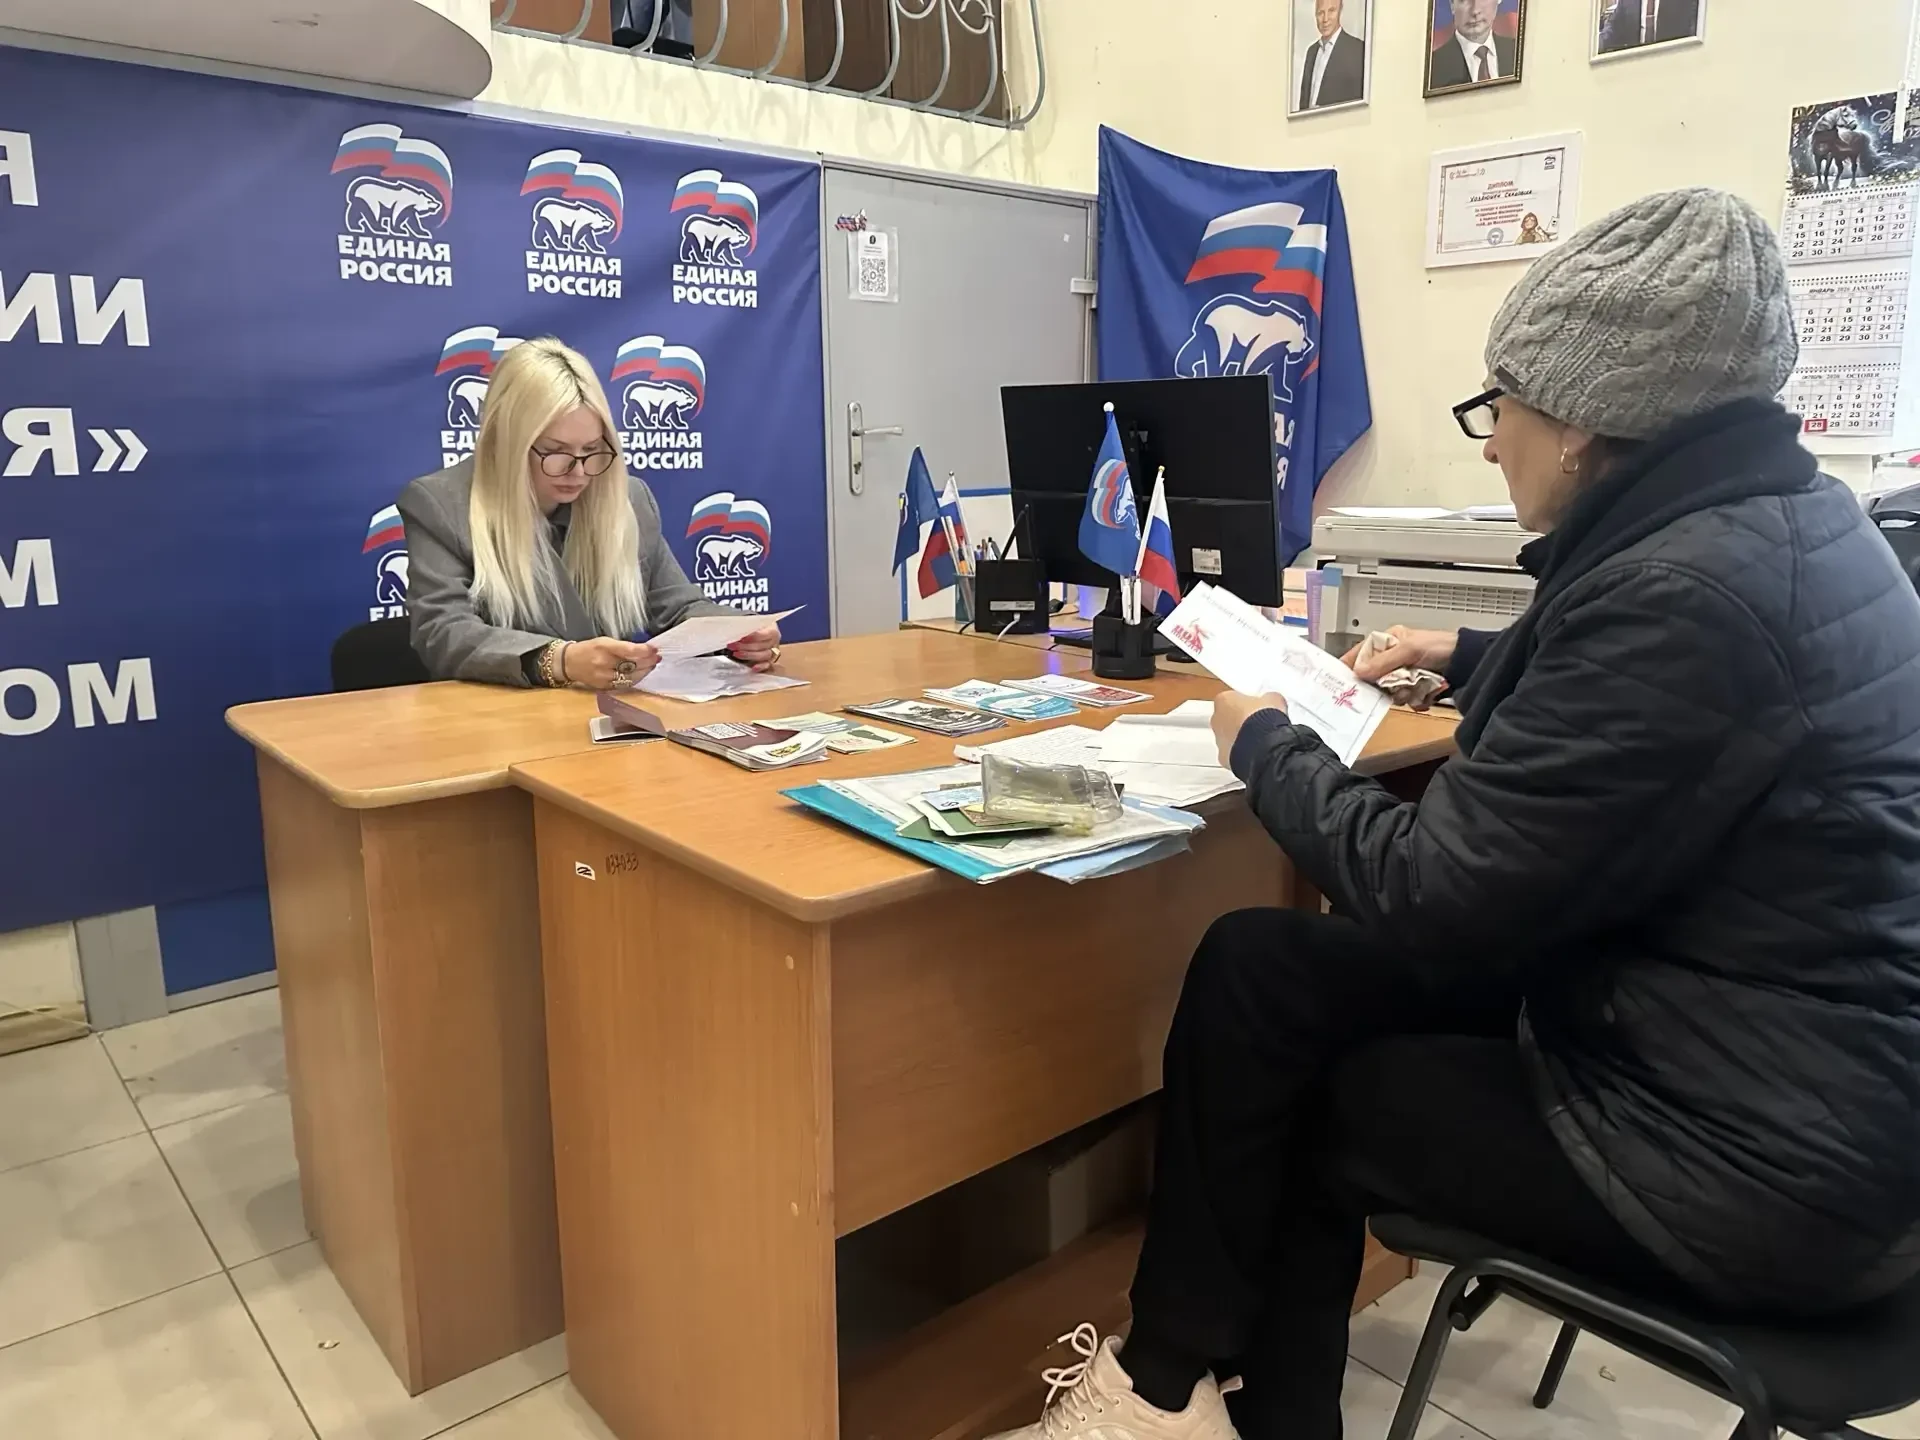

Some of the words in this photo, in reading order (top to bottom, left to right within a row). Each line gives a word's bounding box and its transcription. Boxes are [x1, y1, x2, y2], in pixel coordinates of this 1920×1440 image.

[1867, 192, 1906, 200] DECEMBER
[337, 234, 450, 262] ЕДИНАЯ
[340, 258, 452, 286] РОССИЯ
[526, 251, 621, 276] ЕДИНАЯ
[527, 273, 621, 299] РОССИЯ
[672, 264, 757, 287] ЕДИНАЯ
[673, 285, 757, 308] РОССИЯ
[618, 432, 702, 450] ЕДИНАЯ
[697, 578, 769, 598] ДИНАЯ
